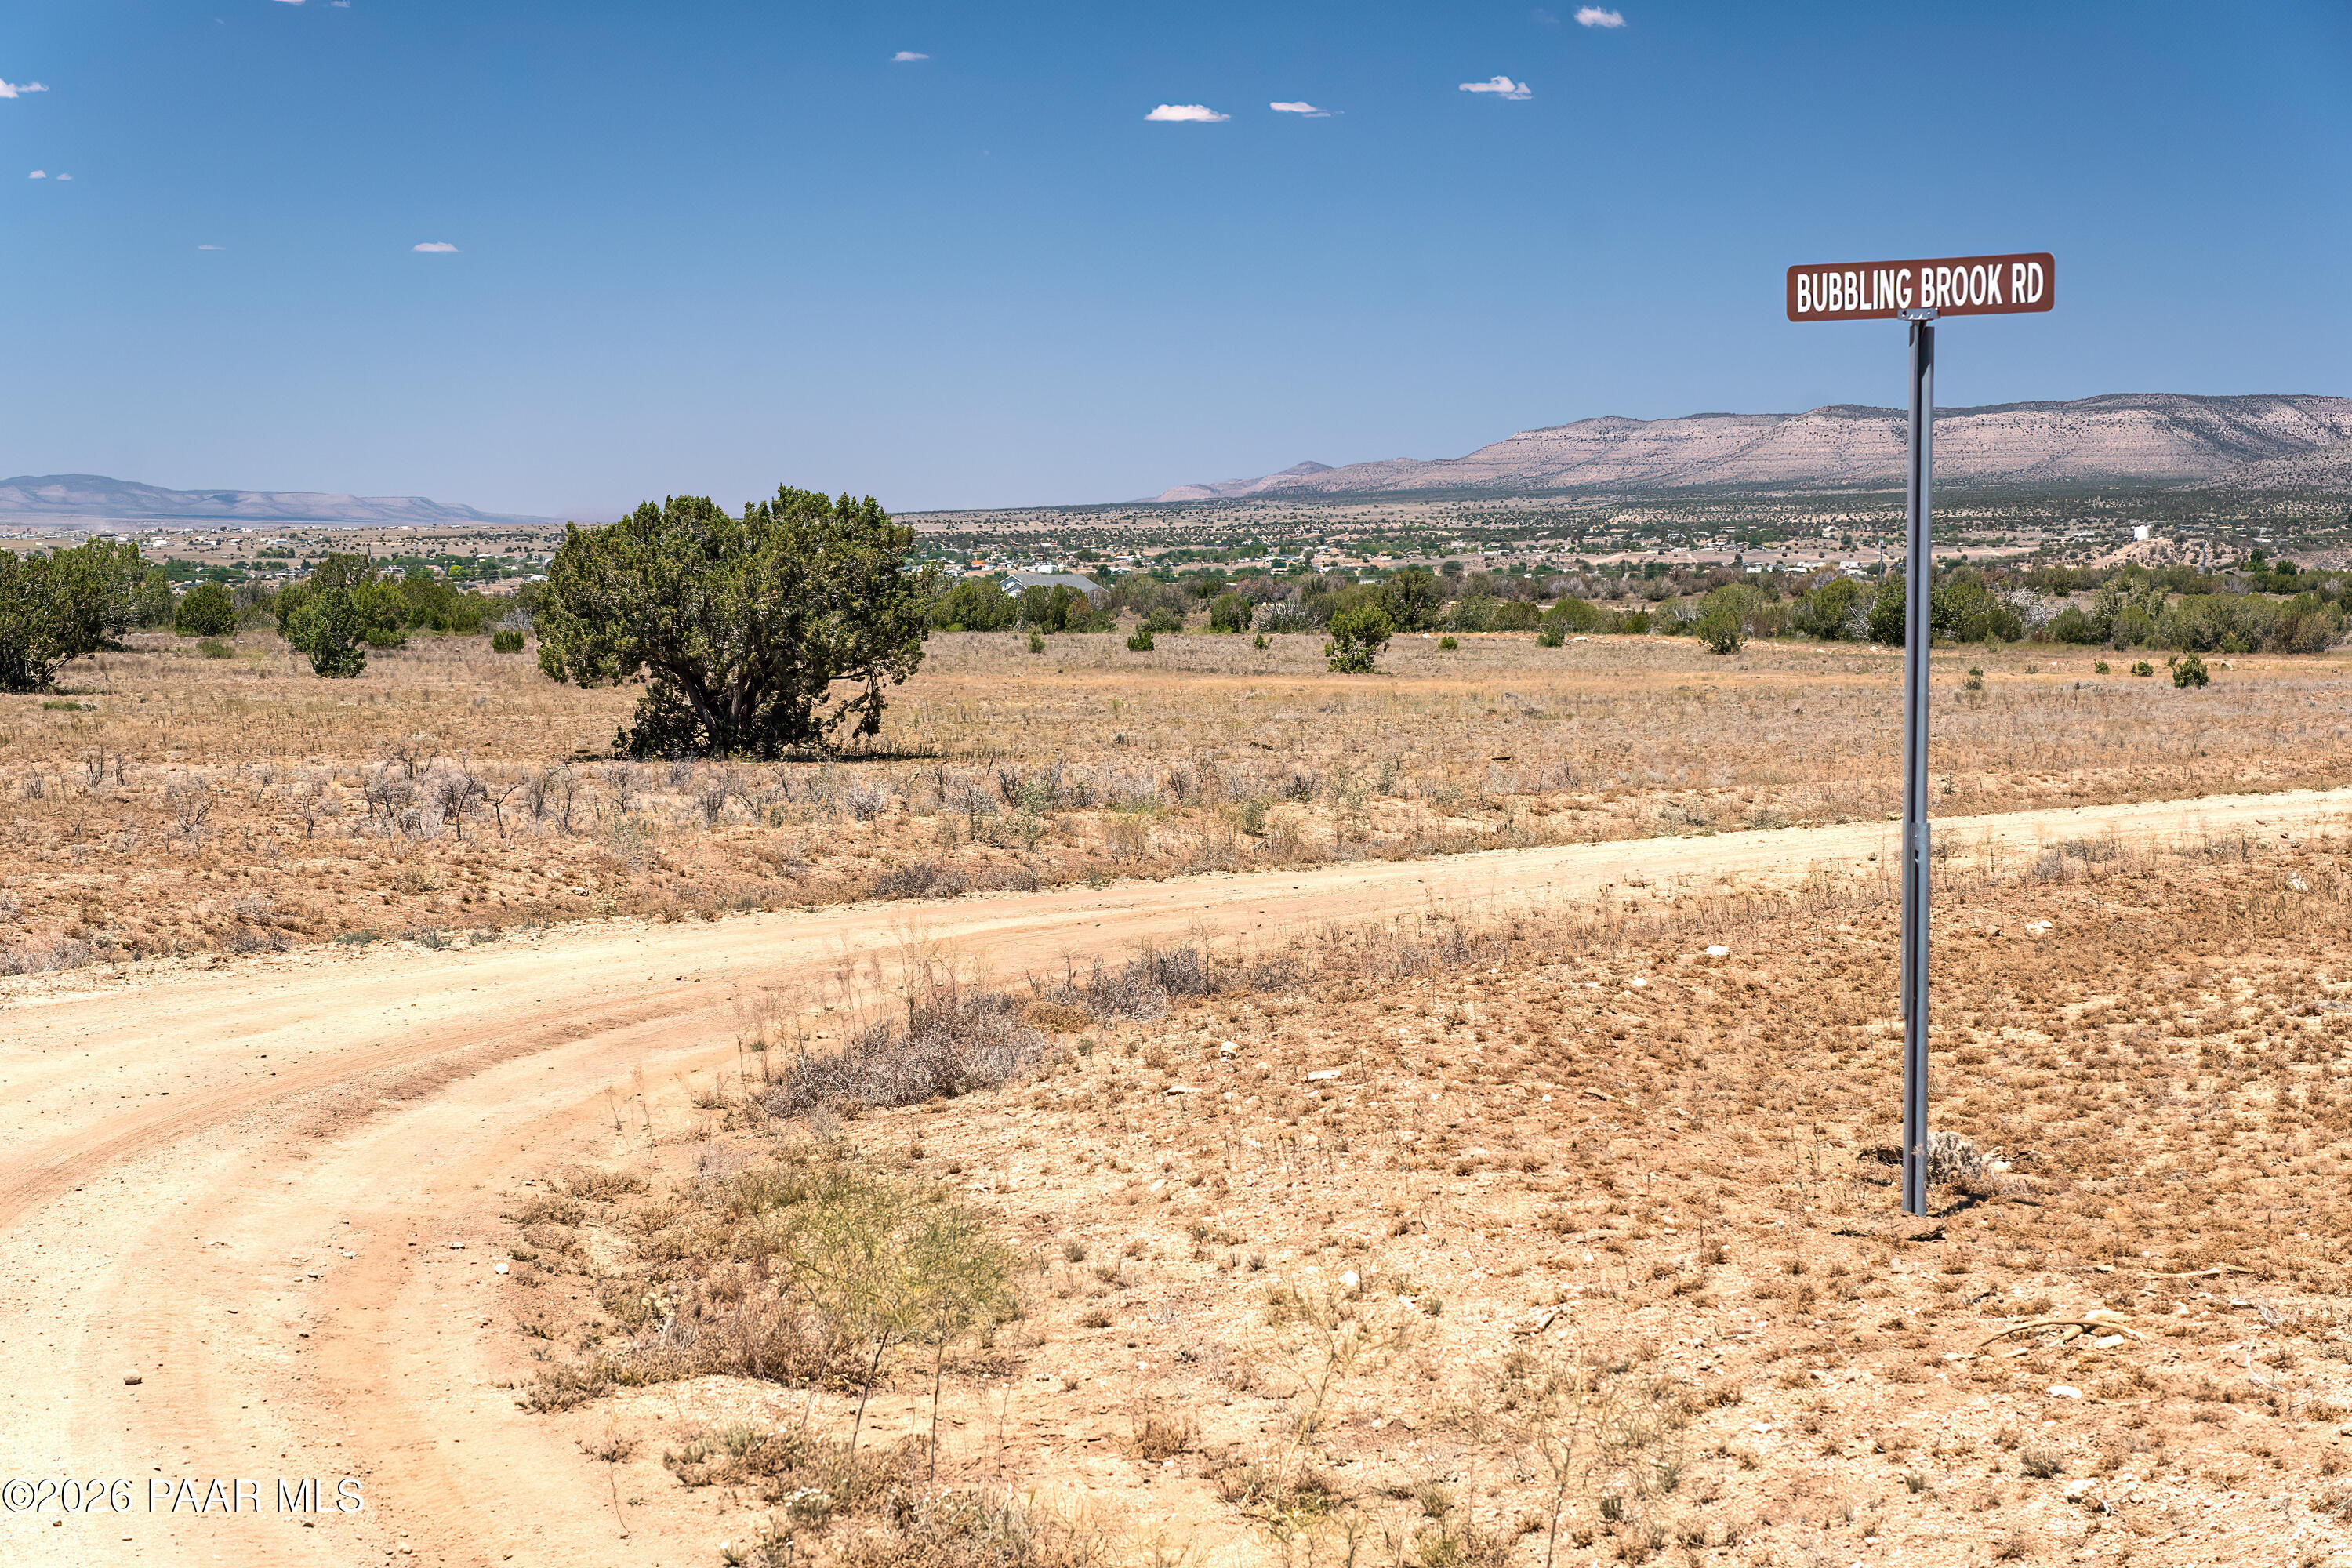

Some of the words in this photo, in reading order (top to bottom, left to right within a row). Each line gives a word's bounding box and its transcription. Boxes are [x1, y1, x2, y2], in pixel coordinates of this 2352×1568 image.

[1797, 268, 1913, 313] BUBBLING
[1921, 263, 2002, 308] BROOK
[2012, 262, 2044, 304] RD
